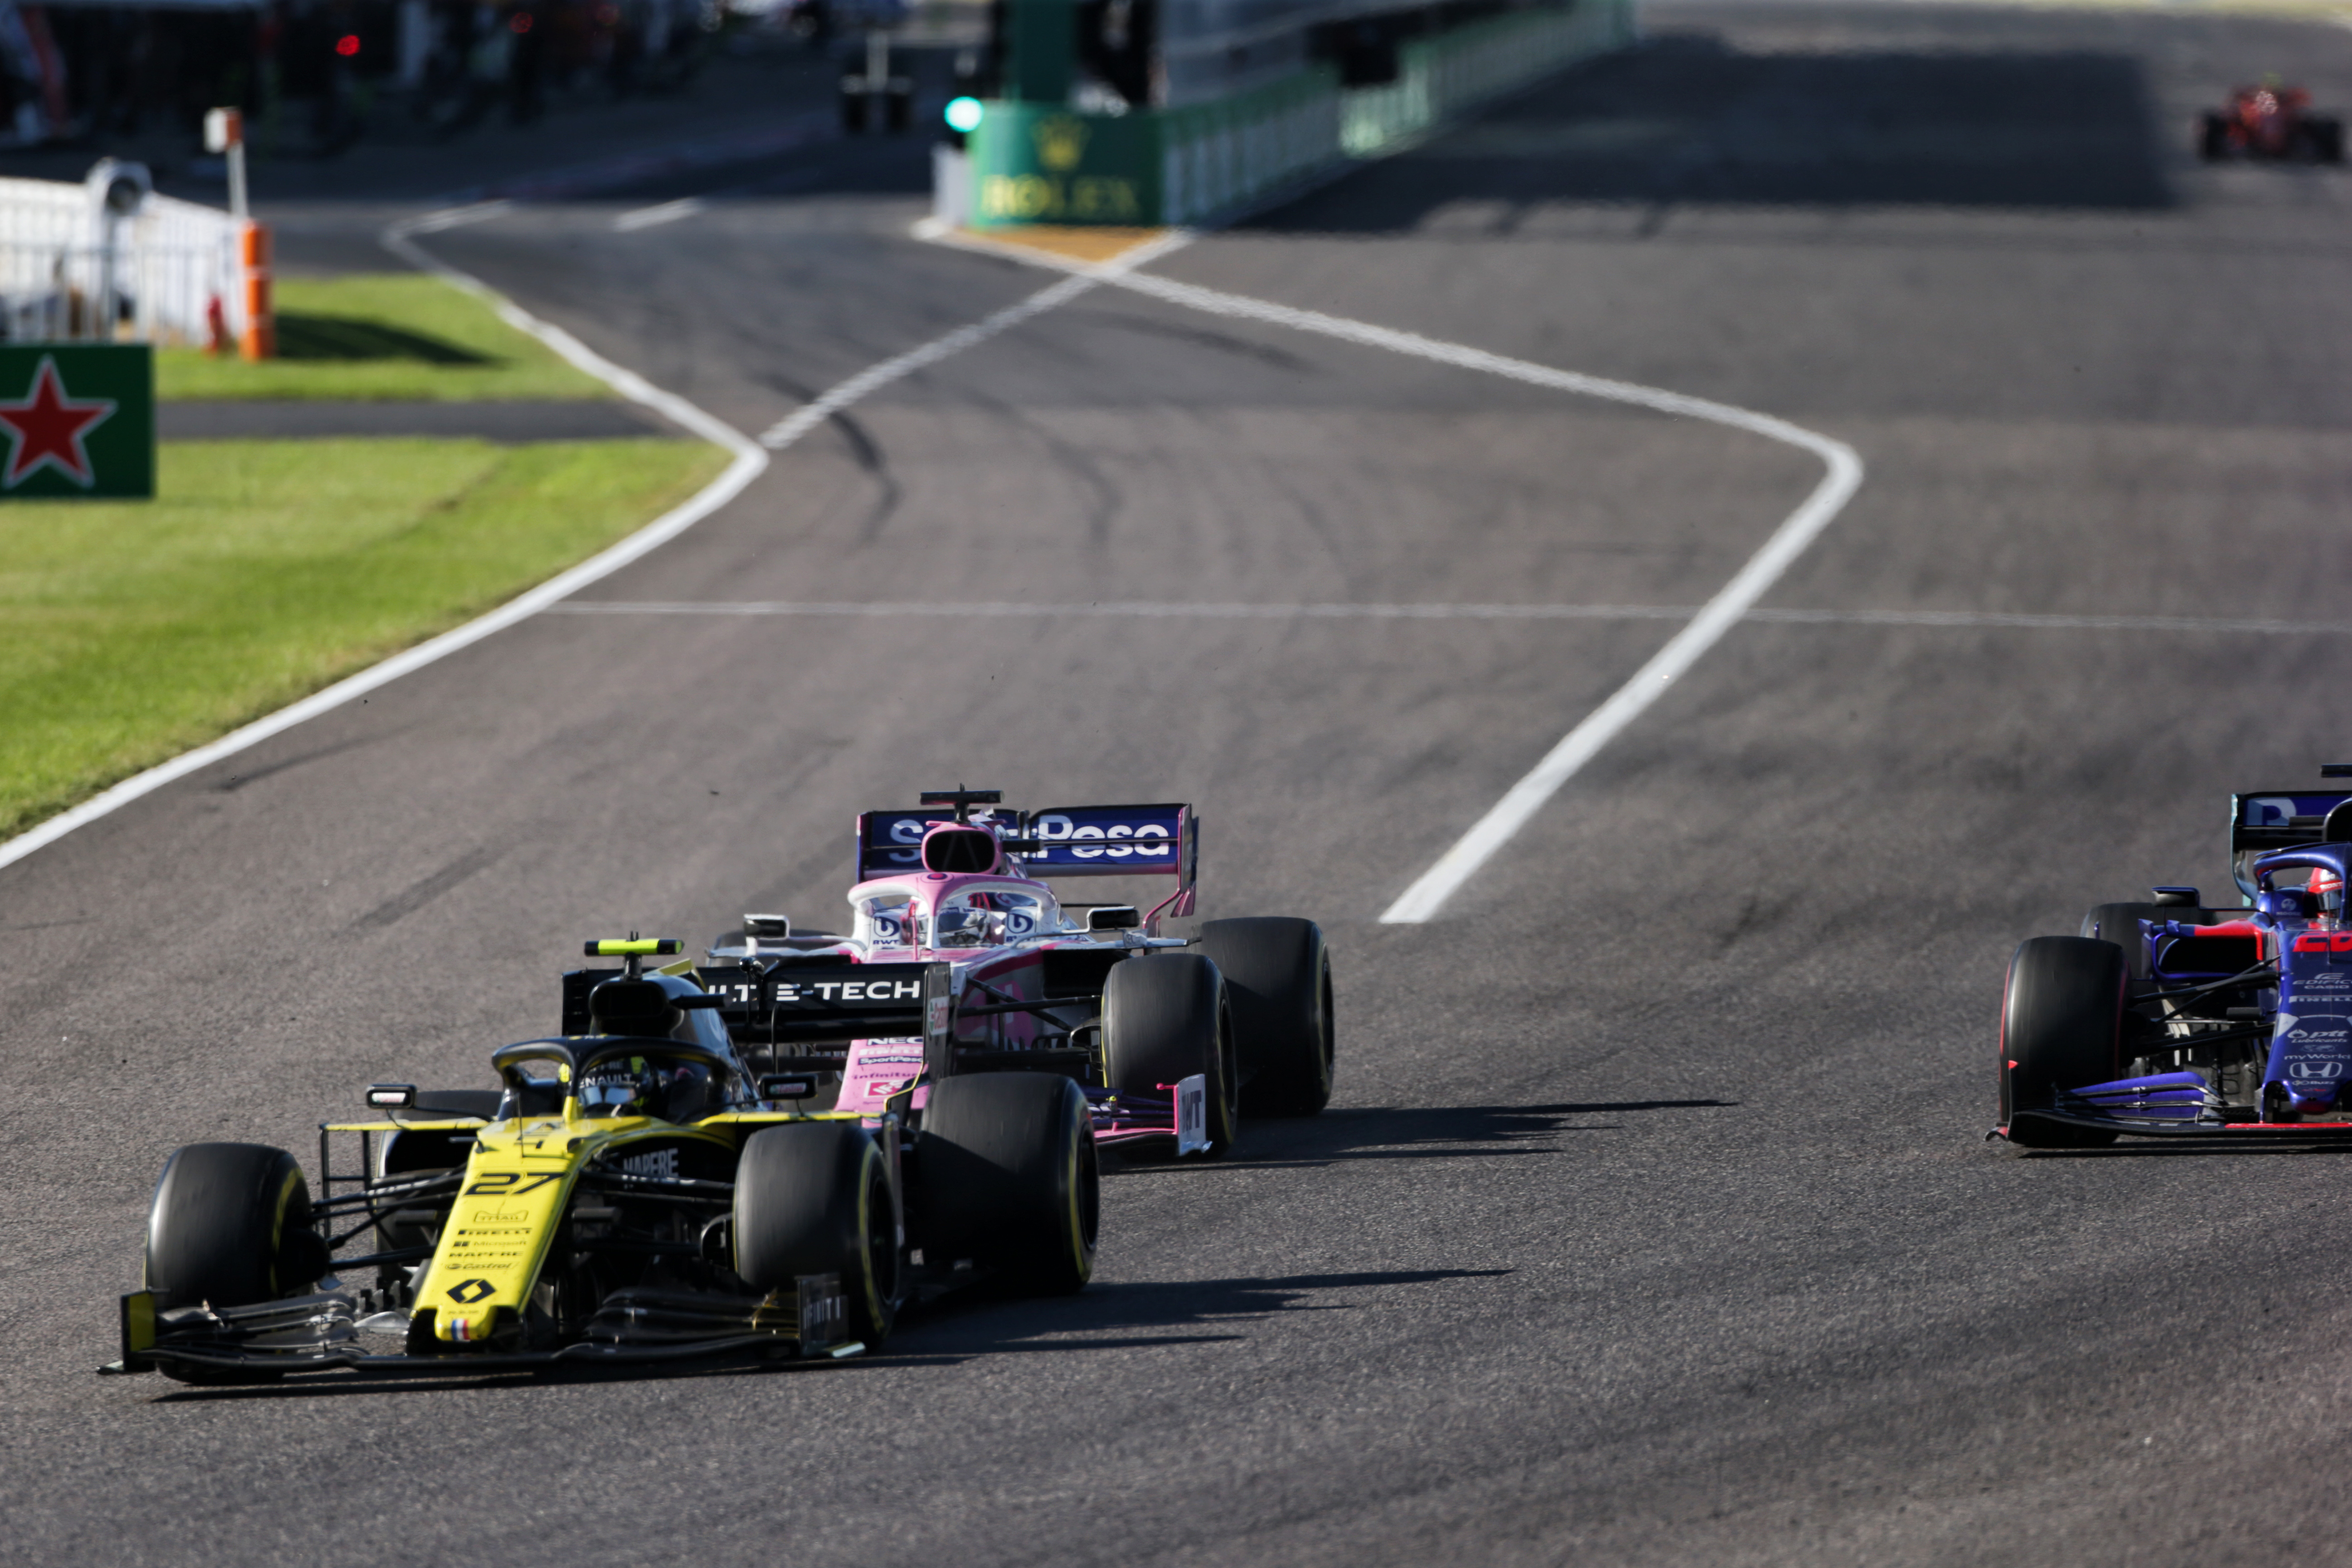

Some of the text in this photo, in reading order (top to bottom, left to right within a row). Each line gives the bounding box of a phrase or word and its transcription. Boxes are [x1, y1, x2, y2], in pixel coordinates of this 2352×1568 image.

[776, 980, 921, 1001] E-TECH
[2308, 1030, 2348, 1038] ptt
[859, 1047, 923, 1055] PIRELL
[464, 1172, 567, 1195] 27
